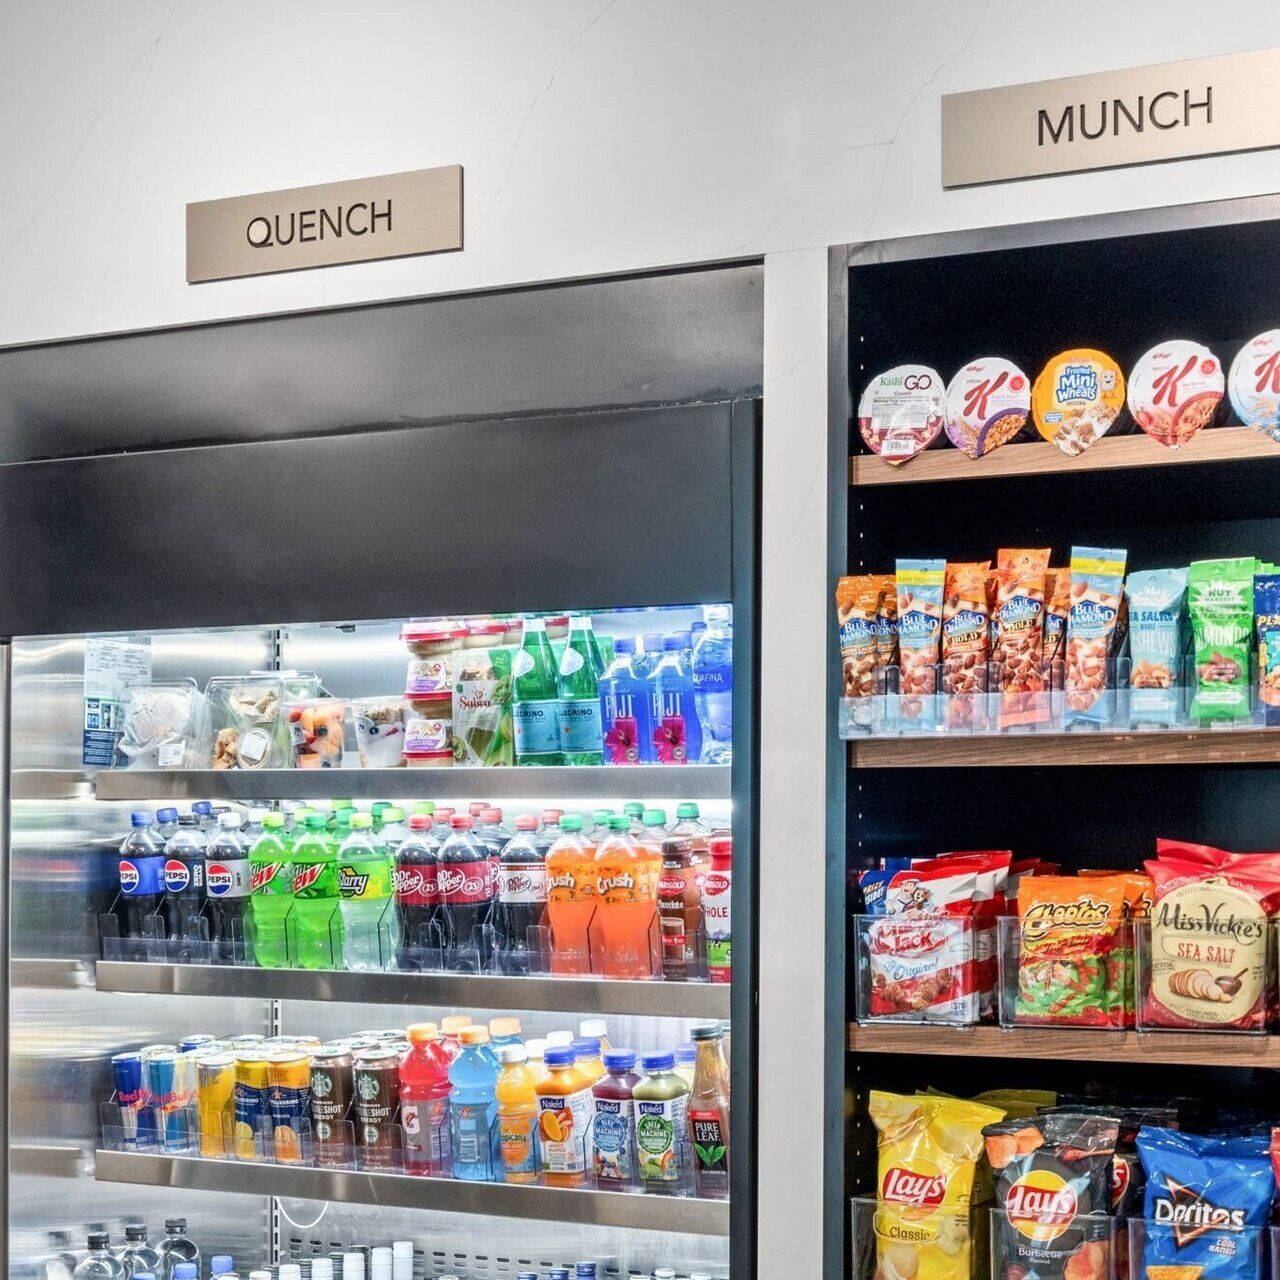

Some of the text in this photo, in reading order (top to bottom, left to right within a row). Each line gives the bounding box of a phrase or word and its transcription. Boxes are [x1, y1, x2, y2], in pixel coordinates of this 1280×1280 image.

[1037, 85, 1215, 147] MUNCH
[246, 200, 394, 249] QUENCH
[1065, 366, 1092, 375] Frosted
[880, 375, 931, 390] Kashi GO
[1060, 374, 1097, 390] Mini
[1152, 355, 1198, 408] K
[963, 371, 1009, 420] K
[1056, 386, 1097, 403] Wheats
[1000, 602, 1040, 619] DIAMOND
[1009, 600, 1029, 608] BLUE
[1076, 604, 1100, 614] BLUE
[903, 615, 925, 626] BLUE
[944, 615, 984, 632] DIAMOND
[953, 613, 973, 623] BLUE
[1009, 620, 1033, 630] BOLD
[845, 622, 867, 633] BLUE
[951, 632, 978, 643] BOLD
[459, 698, 491, 710] Sabra
[605, 693, 635, 719] FIJI
[652, 692, 683, 719] FIJI
[547, 873, 576, 890] rush
[597, 873, 634, 894] Crush
[704, 906, 728, 918] HOLE
[1022, 900, 1112, 939] Cheetos
[1157, 903, 1263, 939] Miss Vickie's
[1177, 943, 1235, 964] SEA SALT
[542, 1100, 564, 1109] Naked
[597, 1103, 619, 1113] Naked
[640, 1105, 663, 1114] Naked
[595, 1128, 622, 1136] MACHINE
[695, 1122, 719, 1131] PURE
[697, 1132, 720, 1141] LEAF
[1155, 1198, 1245, 1231] Doritos
[889, 1226, 931, 1242] Classic
[1018, 1247, 1062, 1260] Barbecue
